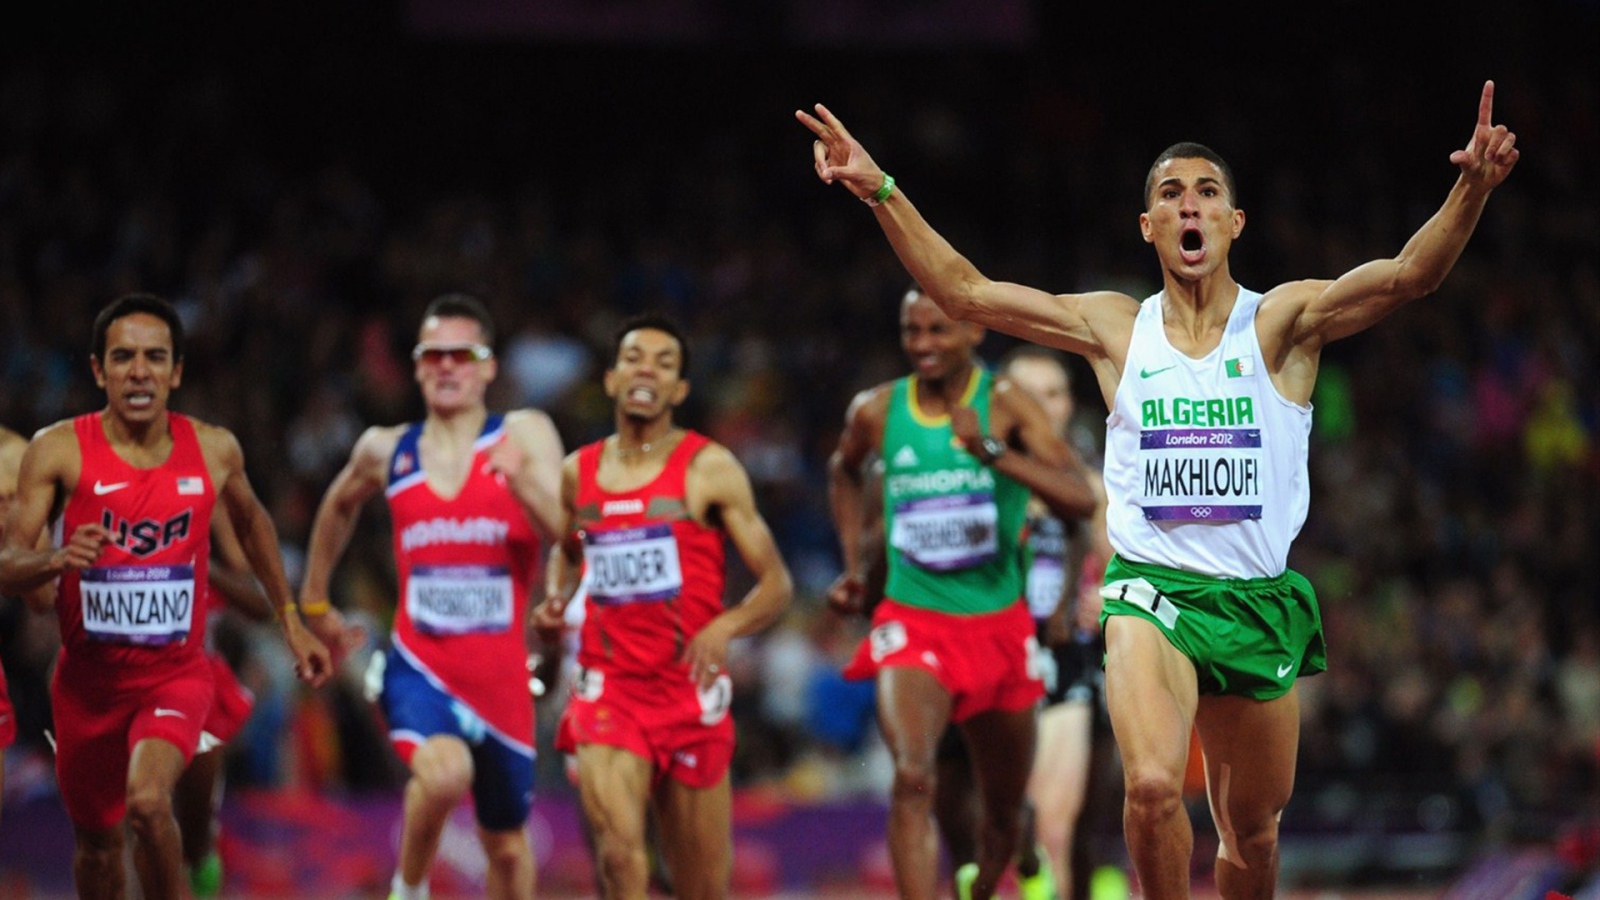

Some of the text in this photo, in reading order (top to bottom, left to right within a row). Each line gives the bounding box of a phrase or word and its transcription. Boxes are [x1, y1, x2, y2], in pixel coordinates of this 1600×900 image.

[1142, 396, 1254, 427] ALGERIA
[1165, 433, 1233, 445] London 2012
[889, 467, 995, 497] ETHIOPIA
[1144, 457, 1258, 497] MAKHLOUFI
[102, 508, 193, 560] USA
[86, 589, 190, 625] MANZANO
